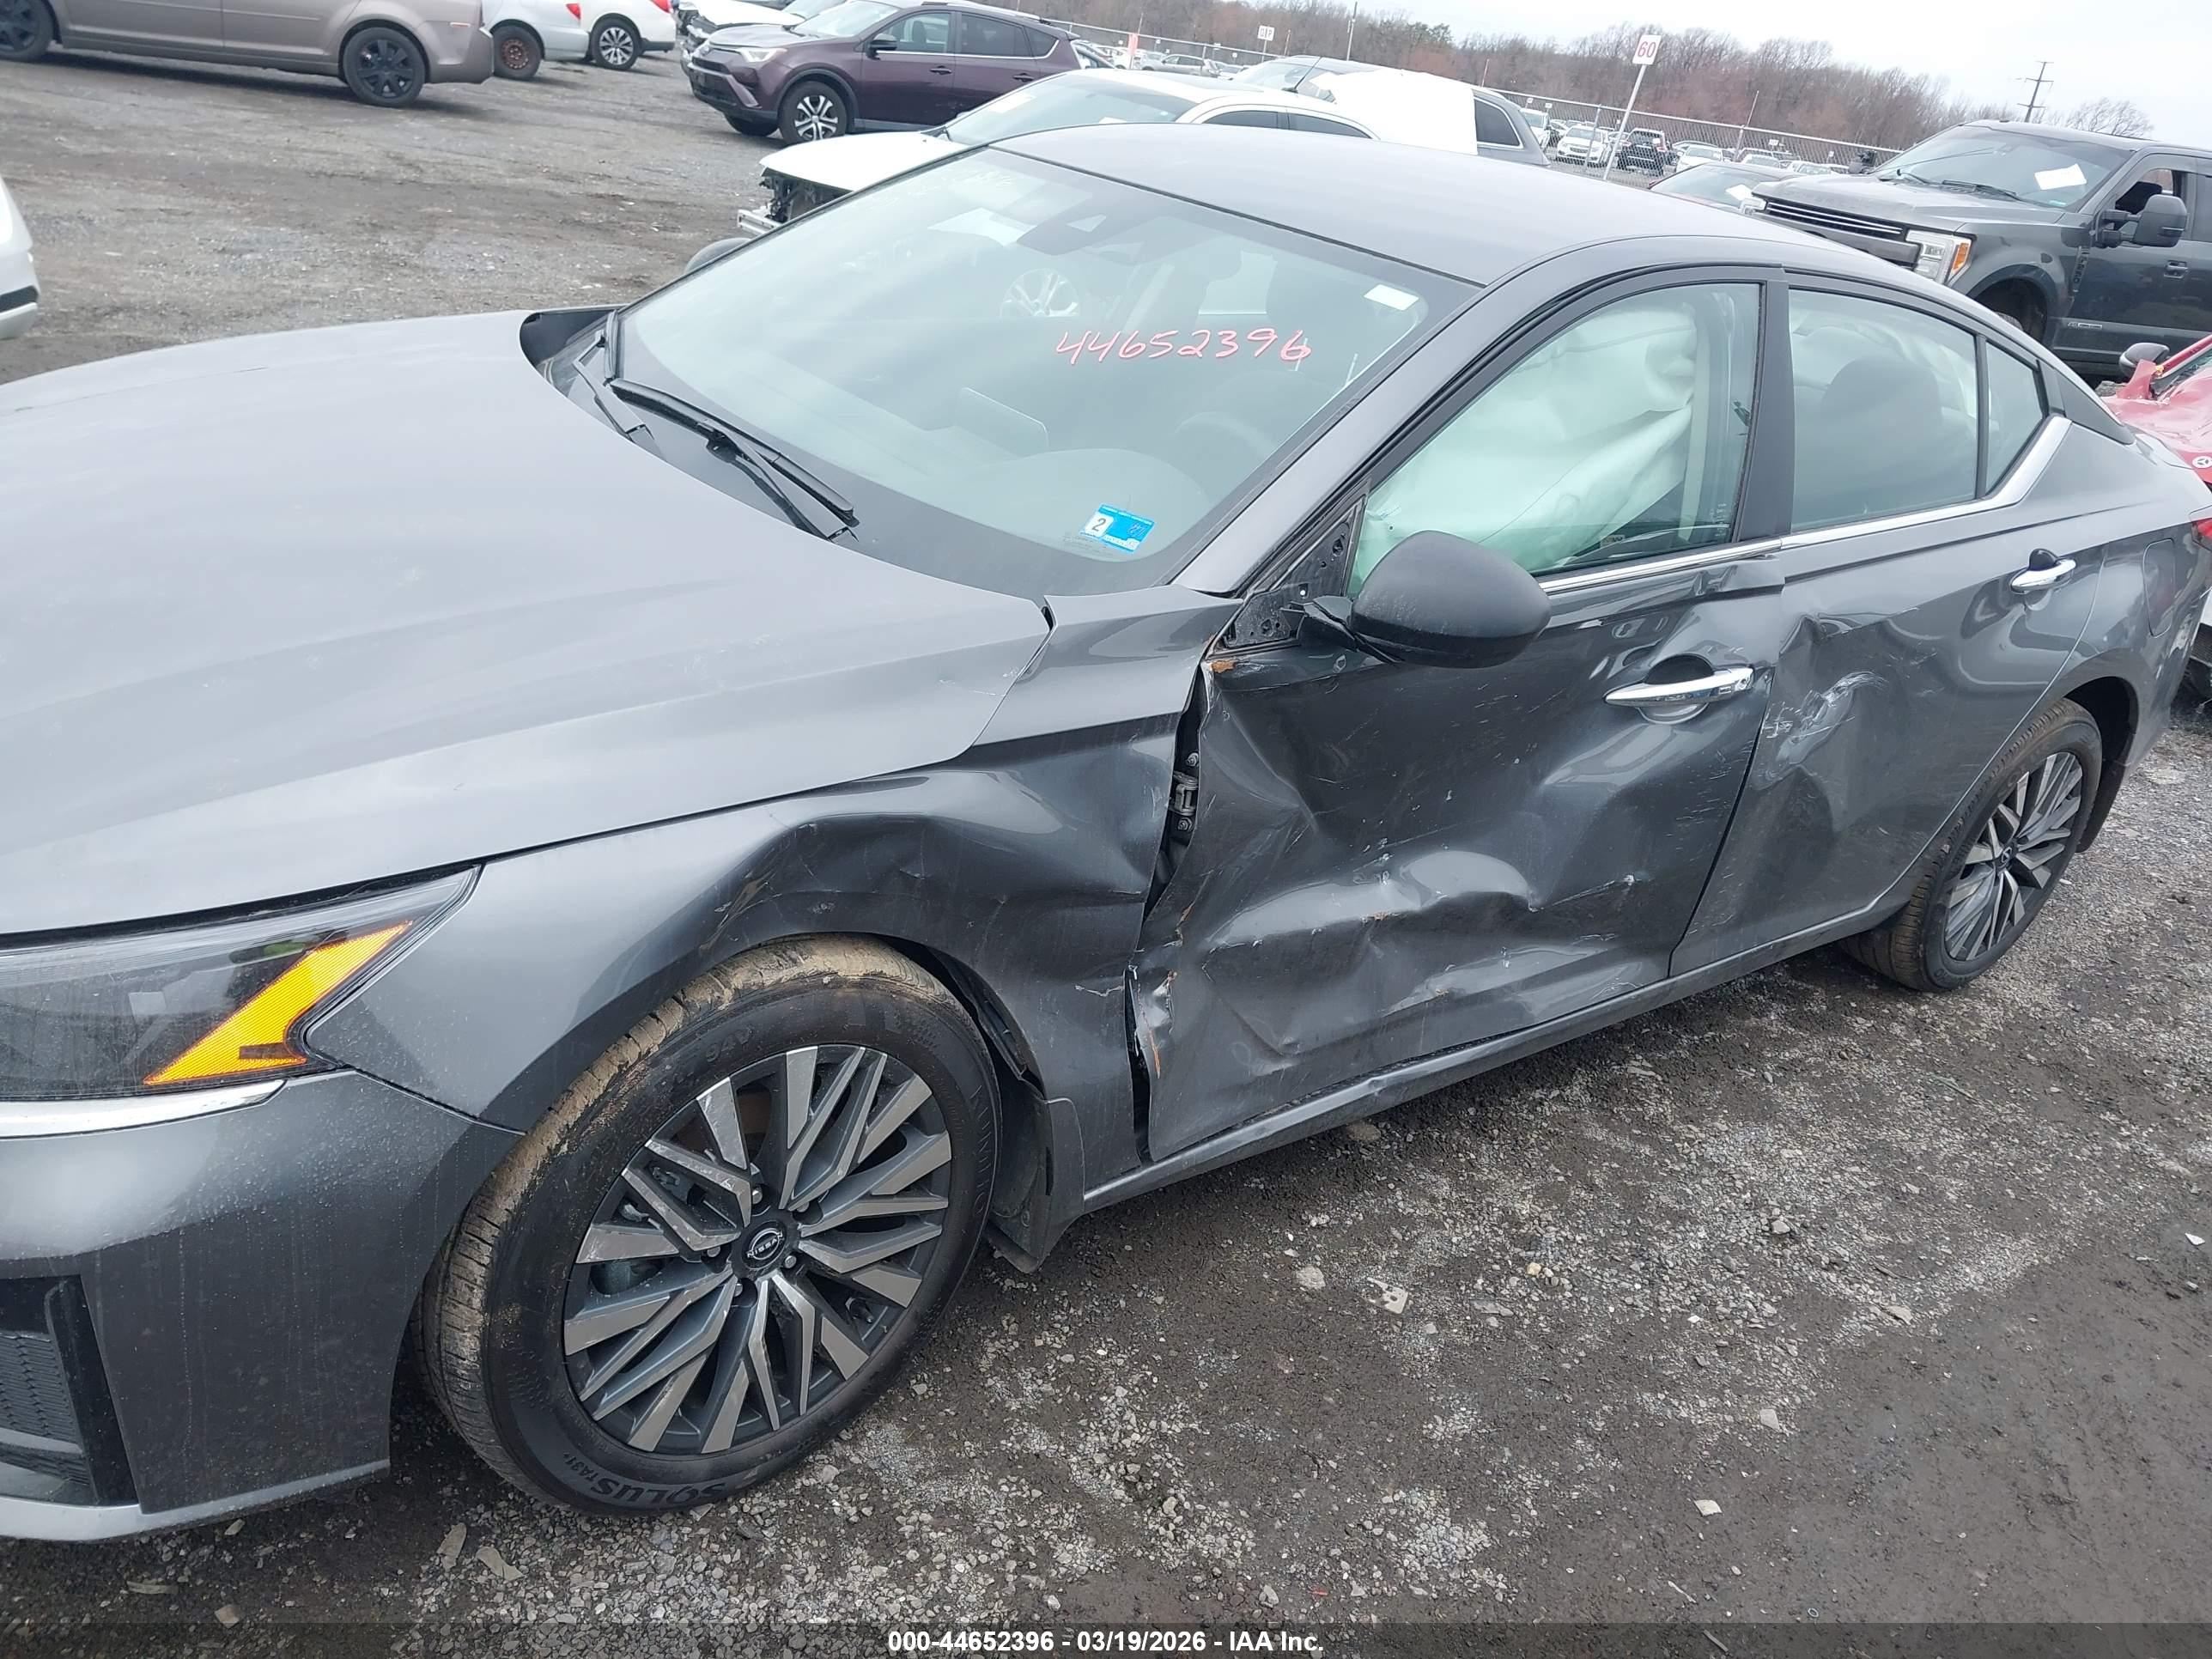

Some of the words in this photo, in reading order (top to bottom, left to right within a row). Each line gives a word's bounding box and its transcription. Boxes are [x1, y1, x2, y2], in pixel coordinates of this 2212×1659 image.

[1638, 40, 1656, 58] 60
[1056, 327, 1312, 364] 44652396
[1091, 517, 1107, 532] 2
[589, 1477, 726, 1503] SOLUS
